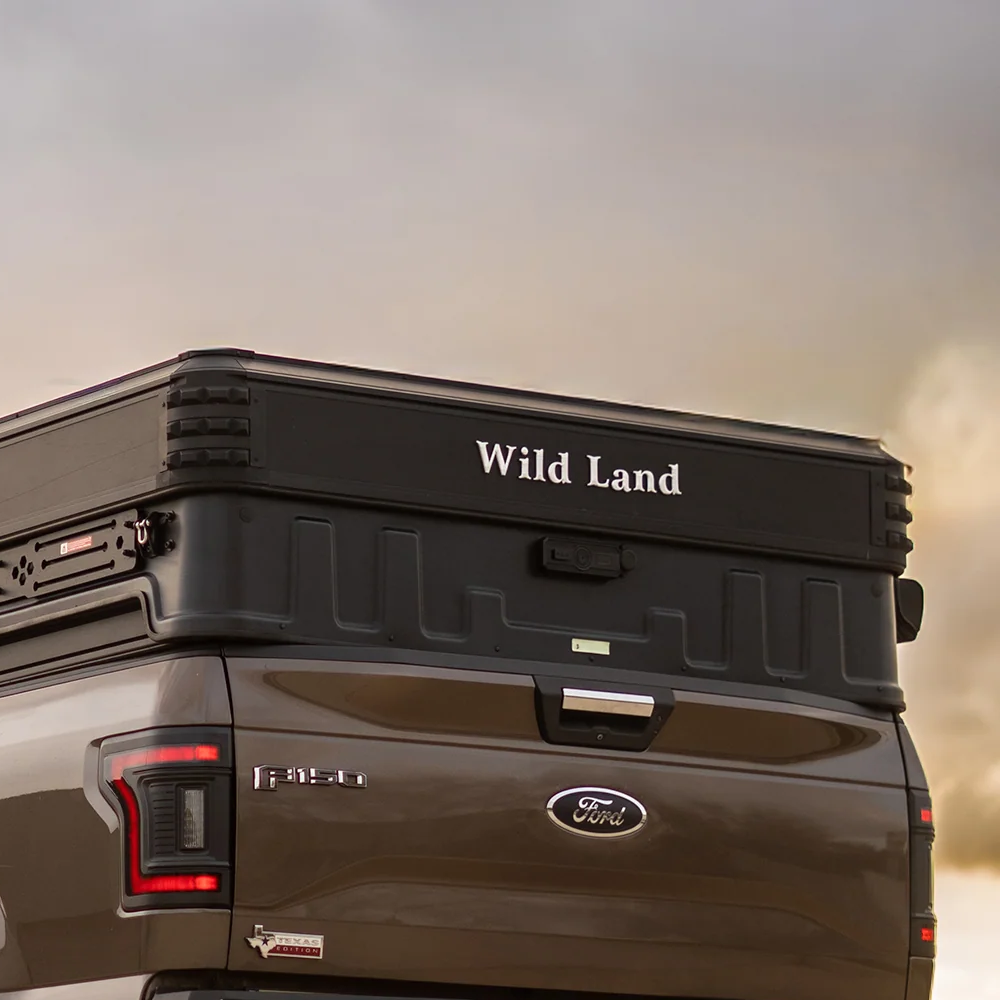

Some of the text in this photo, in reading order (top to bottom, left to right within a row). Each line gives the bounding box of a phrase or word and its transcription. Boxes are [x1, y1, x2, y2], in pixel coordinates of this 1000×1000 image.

[476, 440, 682, 495] Wild Land
[573, 796, 626, 826] Ford
[276, 937, 320, 947] TEXAS
[276, 945, 319, 954] EDITION
